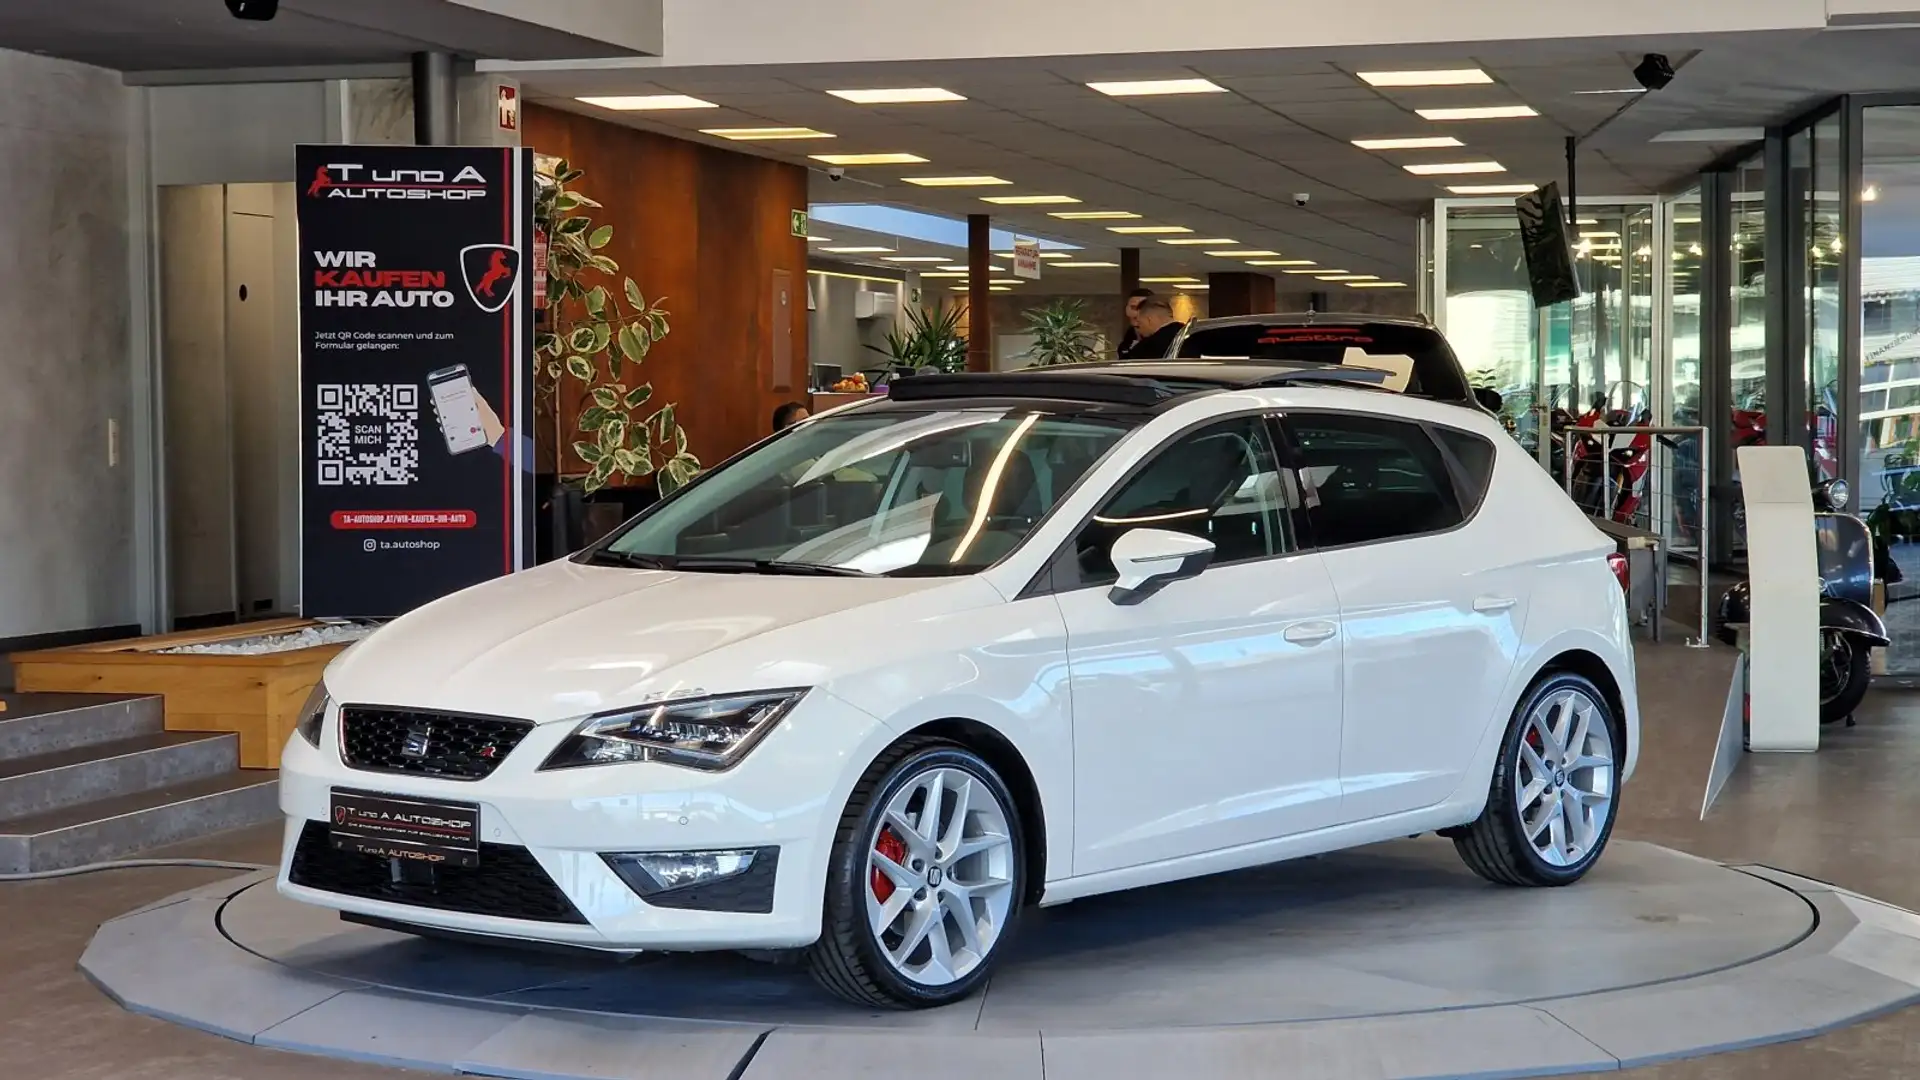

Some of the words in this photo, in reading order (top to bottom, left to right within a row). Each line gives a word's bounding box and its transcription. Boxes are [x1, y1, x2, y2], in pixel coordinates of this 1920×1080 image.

[327, 163, 363, 182] T
[451, 165, 487, 183] A
[327, 187, 487, 200] AUTOSHOP
[313, 250, 377, 268] WIR
[314, 270, 446, 288] KAUFEN
[315, 290, 368, 307] IHR
[370, 290, 455, 307] AUTO
[314, 331, 336, 340] Jetzt
[337, 331, 352, 341] QR
[353, 331, 376, 340] Code
[377, 332, 414, 340] scannen
[416, 331, 433, 340] und
[356, 342, 400, 351] gelangen:
[354, 425, 382, 434] SCAN
[354, 435, 382, 444] MICH
[380, 539, 441, 551] ta.autoshop
[347, 807, 356, 815] T
[380, 811, 390, 820] A
[394, 813, 472, 828] AUTOSHOP
[388, 848, 446, 862] AUTOSHOP
